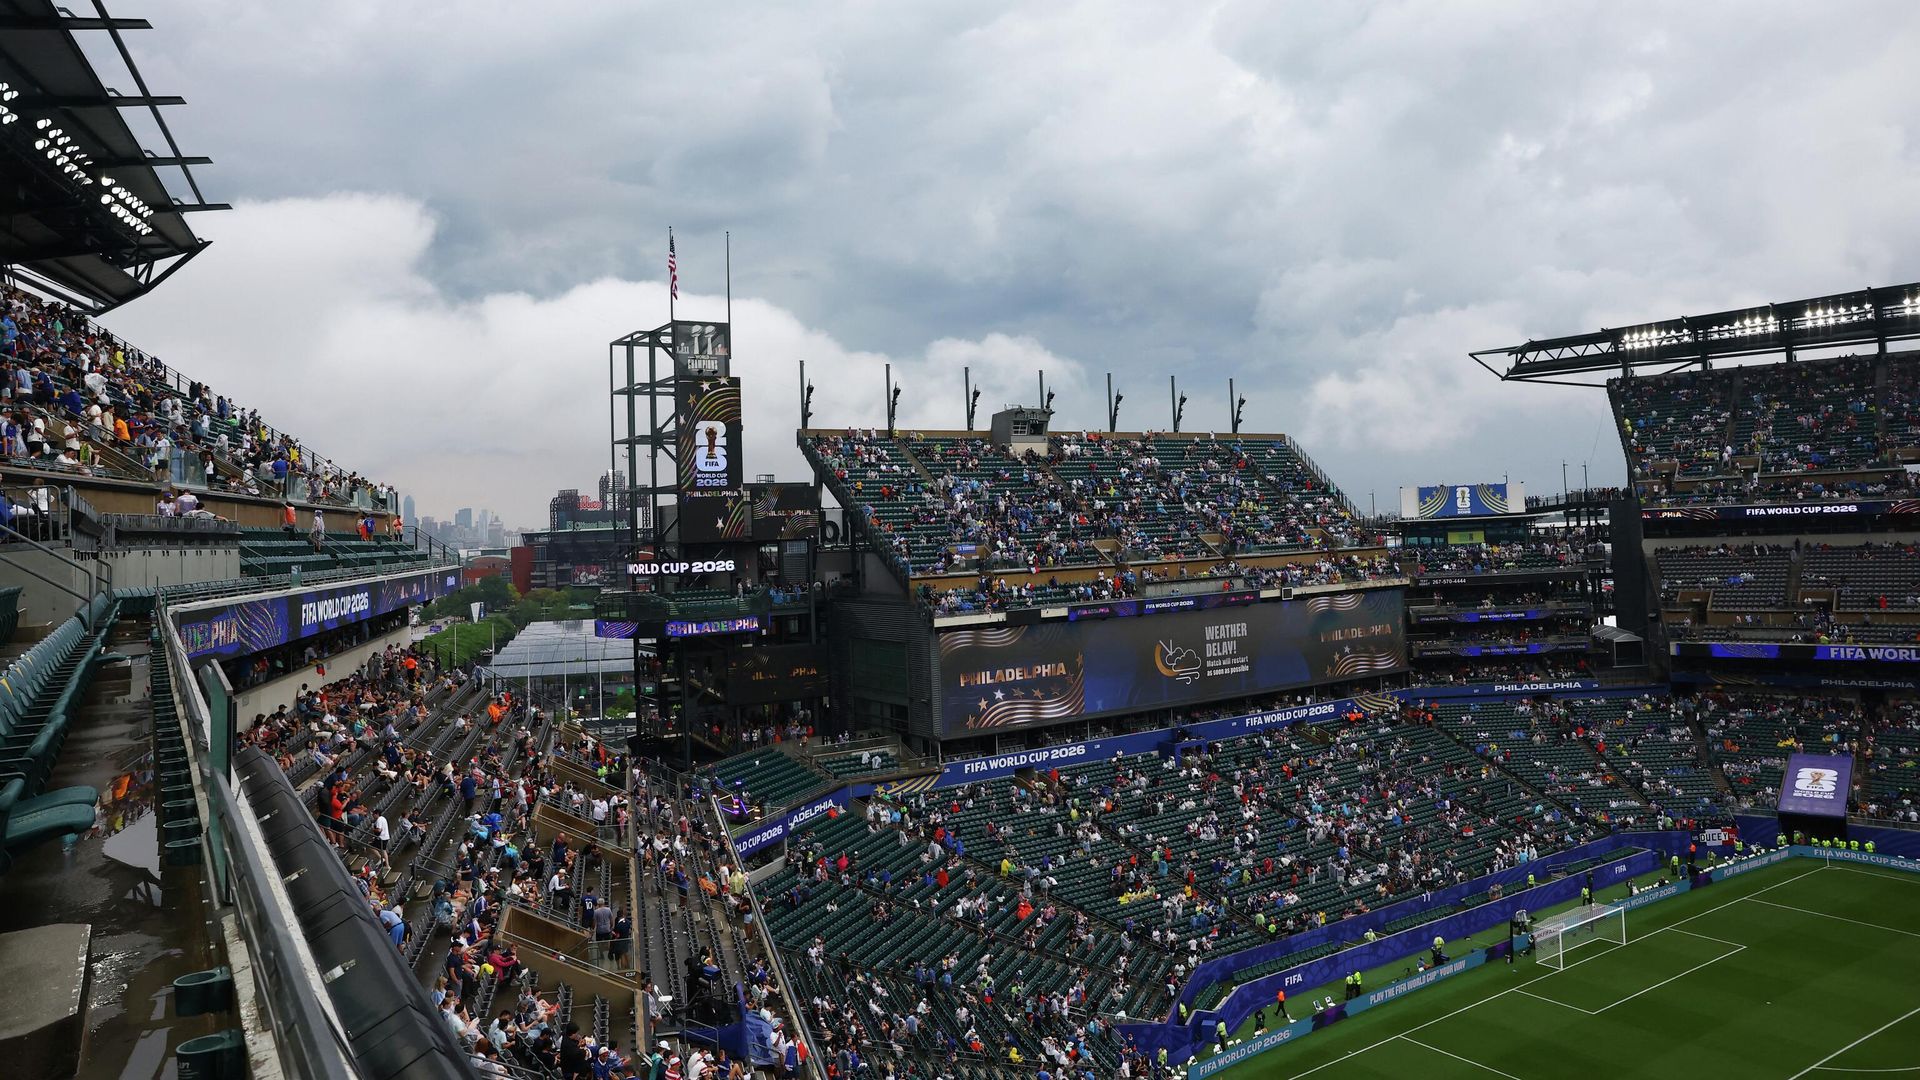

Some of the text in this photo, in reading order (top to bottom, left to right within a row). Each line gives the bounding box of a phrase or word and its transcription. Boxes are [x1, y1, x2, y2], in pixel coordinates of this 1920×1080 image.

[662, 563, 689, 574] CUP
[691, 560, 735, 573] 2026
[302, 592, 369, 626] FIFA WORLD CUP 2026
[667, 618, 759, 635] PHILADELPHIA
[1205, 622, 1247, 640] WEATHER
[1206, 640, 1237, 658] DELAY!
[1830, 648, 1866, 659] FIFA
[1233, 656, 1249, 664] restart
[960, 662, 1067, 687] PHILADELPHIA
[1231, 664, 1249, 674] possible
[1494, 682, 1582, 692] PHILADELPHIA
[1821, 679, 1915, 688] PHILADELPHIA
[1246, 716, 1263, 727] FIFA
[1264, 711, 1292, 723] WORLD
[1293, 706, 1308, 718] CUP
[1309, 704, 1335, 716] 2026
[964, 762, 987, 774] FIFA
[989, 756, 1027, 771] WORLD
[1029, 751, 1049, 763] CUP
[1050, 745, 1086, 760] 2026
[748, 836, 760, 848] CUP
[761, 825, 782, 841] 2026
[1700, 832, 1728, 841] DUCEY
[1835, 851, 1868, 860] WORLD
[1870, 856, 1889, 864] CUP
[1615, 864, 1626, 874] FIFA
[1631, 895, 1648, 906] WORLD
[1650, 892, 1659, 900] CUP
[1660, 886, 1676, 897] 2026
[585, 901, 593, 910] 10
[1285, 973, 1302, 986] FIFA
[1370, 994, 1383, 1004] PLAY
[1385, 987, 1395, 999] THE
[1395, 982, 1406, 995] FIFA
[1407, 976, 1426, 990] WORLD
[1440, 964, 1453, 976] YOUR
[1454, 960, 1466, 972] WAY
[1200, 1030, 1289, 1076] FIFA WORLD CUP 2026
